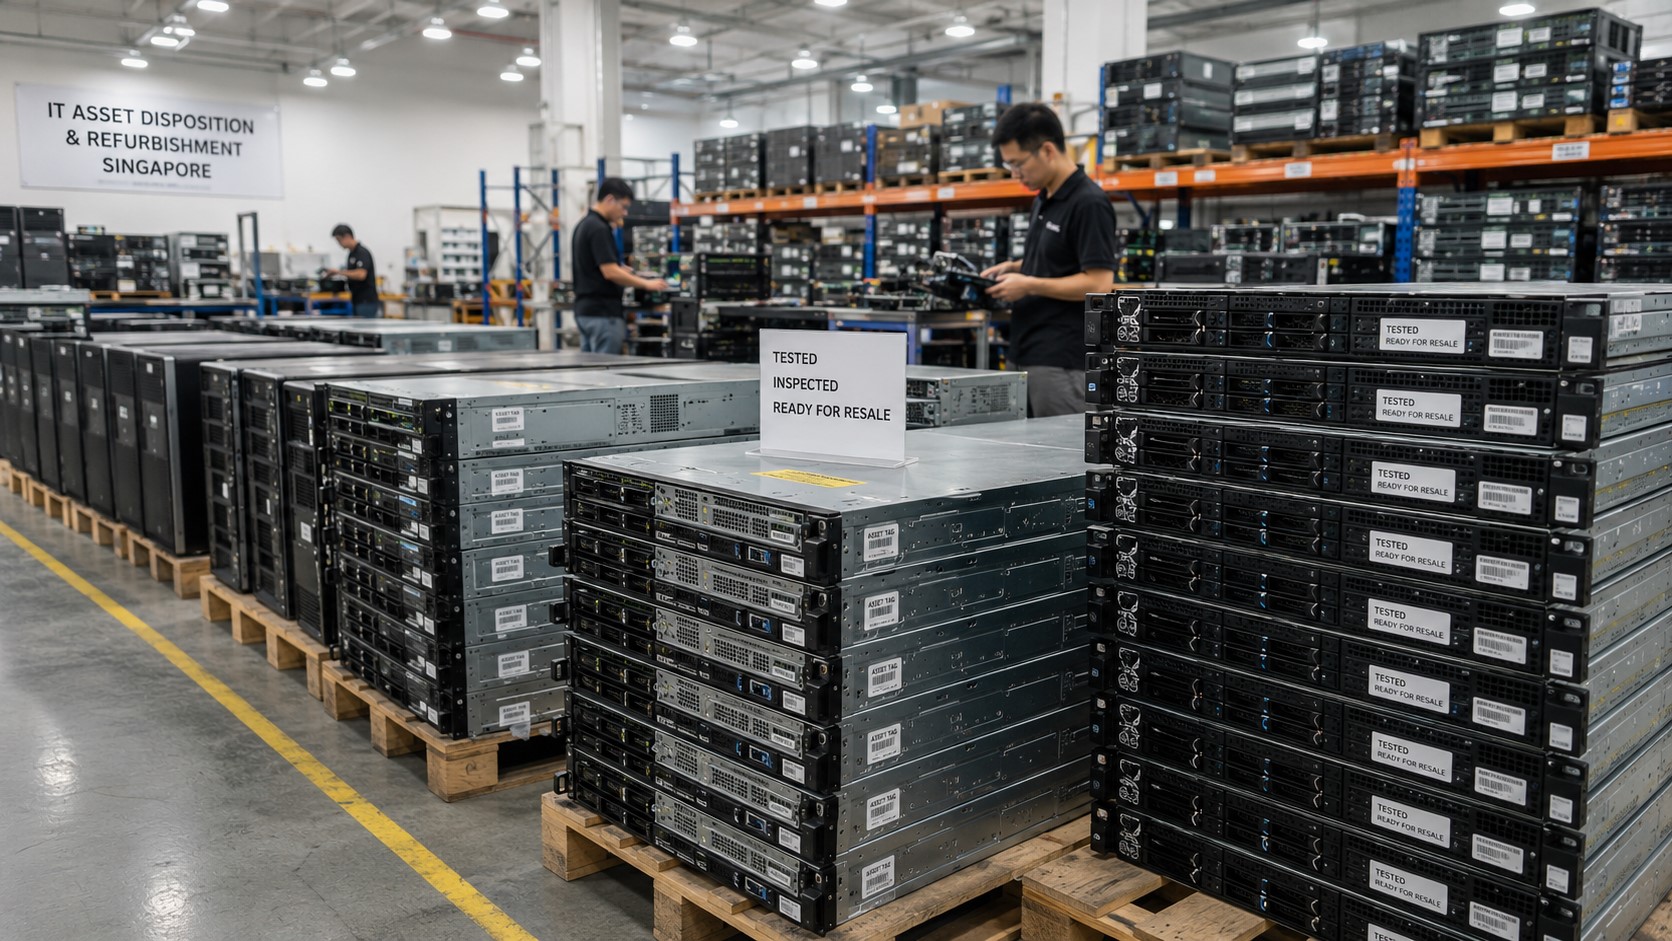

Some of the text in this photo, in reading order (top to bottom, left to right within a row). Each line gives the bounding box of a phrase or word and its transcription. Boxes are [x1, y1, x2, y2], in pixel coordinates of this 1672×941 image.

[48, 102, 254, 134] IT ASSET DISPOSITION
[66, 129, 243, 157] & REFURBISHMENT
[103, 157, 212, 179] SINGAPORE
[1386, 325, 1419, 334] TESTED
[1386, 337, 1458, 347] READY FOR RESALE
[773, 351, 818, 365] TESTED
[773, 376, 839, 392] INSPECTED
[1383, 396, 1415, 407] TESTED
[773, 401, 891, 421] READY FOR RESALE
[1382, 409, 1454, 421] READY FOR RESALE
[1378, 469, 1410, 480] TESTED
[1378, 481, 1448, 496] READY FOR RESALE
[1376, 538, 1408, 550] TESTED
[1375, 550, 1446, 568] READY FOR RESALE
[1374, 606, 1406, 619] TESTED
[1374, 618, 1444, 639] READY FOR RESALE
[1375, 673, 1406, 687] TESTED
[1400, 689, 1414, 700] FOR
[1416, 693, 1443, 707] RESALE
[1378, 739, 1409, 755] TESTED
[1402, 758, 1417, 768] FOR
[1418, 763, 1445, 777] RESALE
[1377, 803, 1408, 819] TESTED
[1401, 821, 1416, 832] FOR
[1417, 826, 1444, 841] RESALE
[1375, 868, 1406, 885] TESTED
[1399, 886, 1414, 898] FOR
[1415, 892, 1441, 908] RESALE
